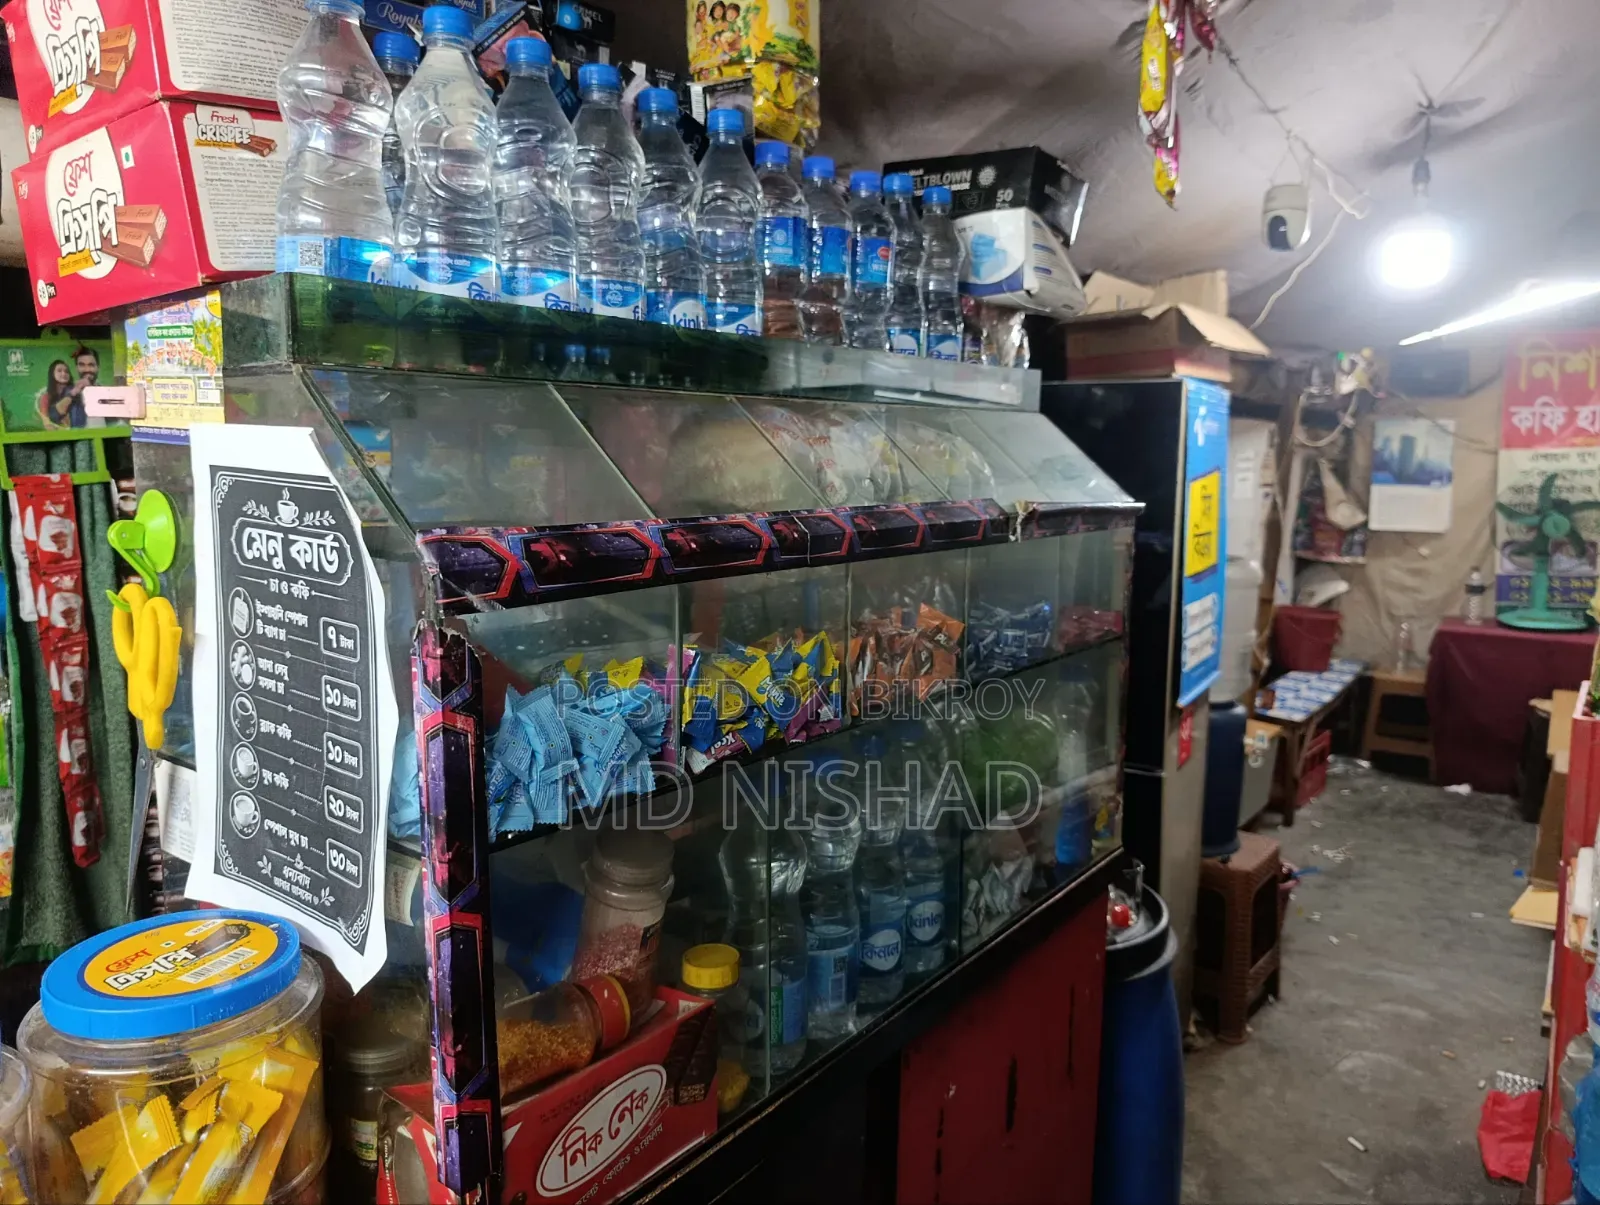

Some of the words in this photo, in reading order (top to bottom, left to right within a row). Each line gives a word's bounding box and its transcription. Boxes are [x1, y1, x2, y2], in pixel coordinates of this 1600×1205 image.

[211, 110, 239, 124] Fresh
[198, 124, 251, 144] CRISPEE
[997, 189, 1014, 202] 50
[1508, 395, 1569, 436] কফি
[242, 527, 286, 571] মেনু
[288, 533, 340, 574] কার্ড
[269, 578, 279, 593] চা
[280, 581, 289, 595] ও
[290, 580, 310, 600] কফি
[327, 626, 337, 649] ৭
[339, 634, 354, 650] টাকা
[258, 657, 274, 674] আদা
[274, 663, 289, 681] লেবু
[277, 681, 285, 694] চা
[325, 684, 341, 706] ১০
[342, 693, 357, 710] টাকা
[276, 723, 292, 741] কফি
[327, 741, 342, 763] ১০
[343, 750, 358, 768] টাকা
[262, 768, 273, 785] দুধ
[273, 772, 289, 790] কফি
[329, 794, 344, 817] ২০
[345, 804, 360, 822] টাকা
[288, 829, 300, 847] দুধ
[300, 835, 308, 849] চা
[329, 849, 346, 871] ৩০
[346, 858, 359, 877] টাকা
[282, 865, 311, 889] ধন্যবাদ
[560, 1126, 605, 1184] নিক
[608, 1086, 650, 1139] নেক
